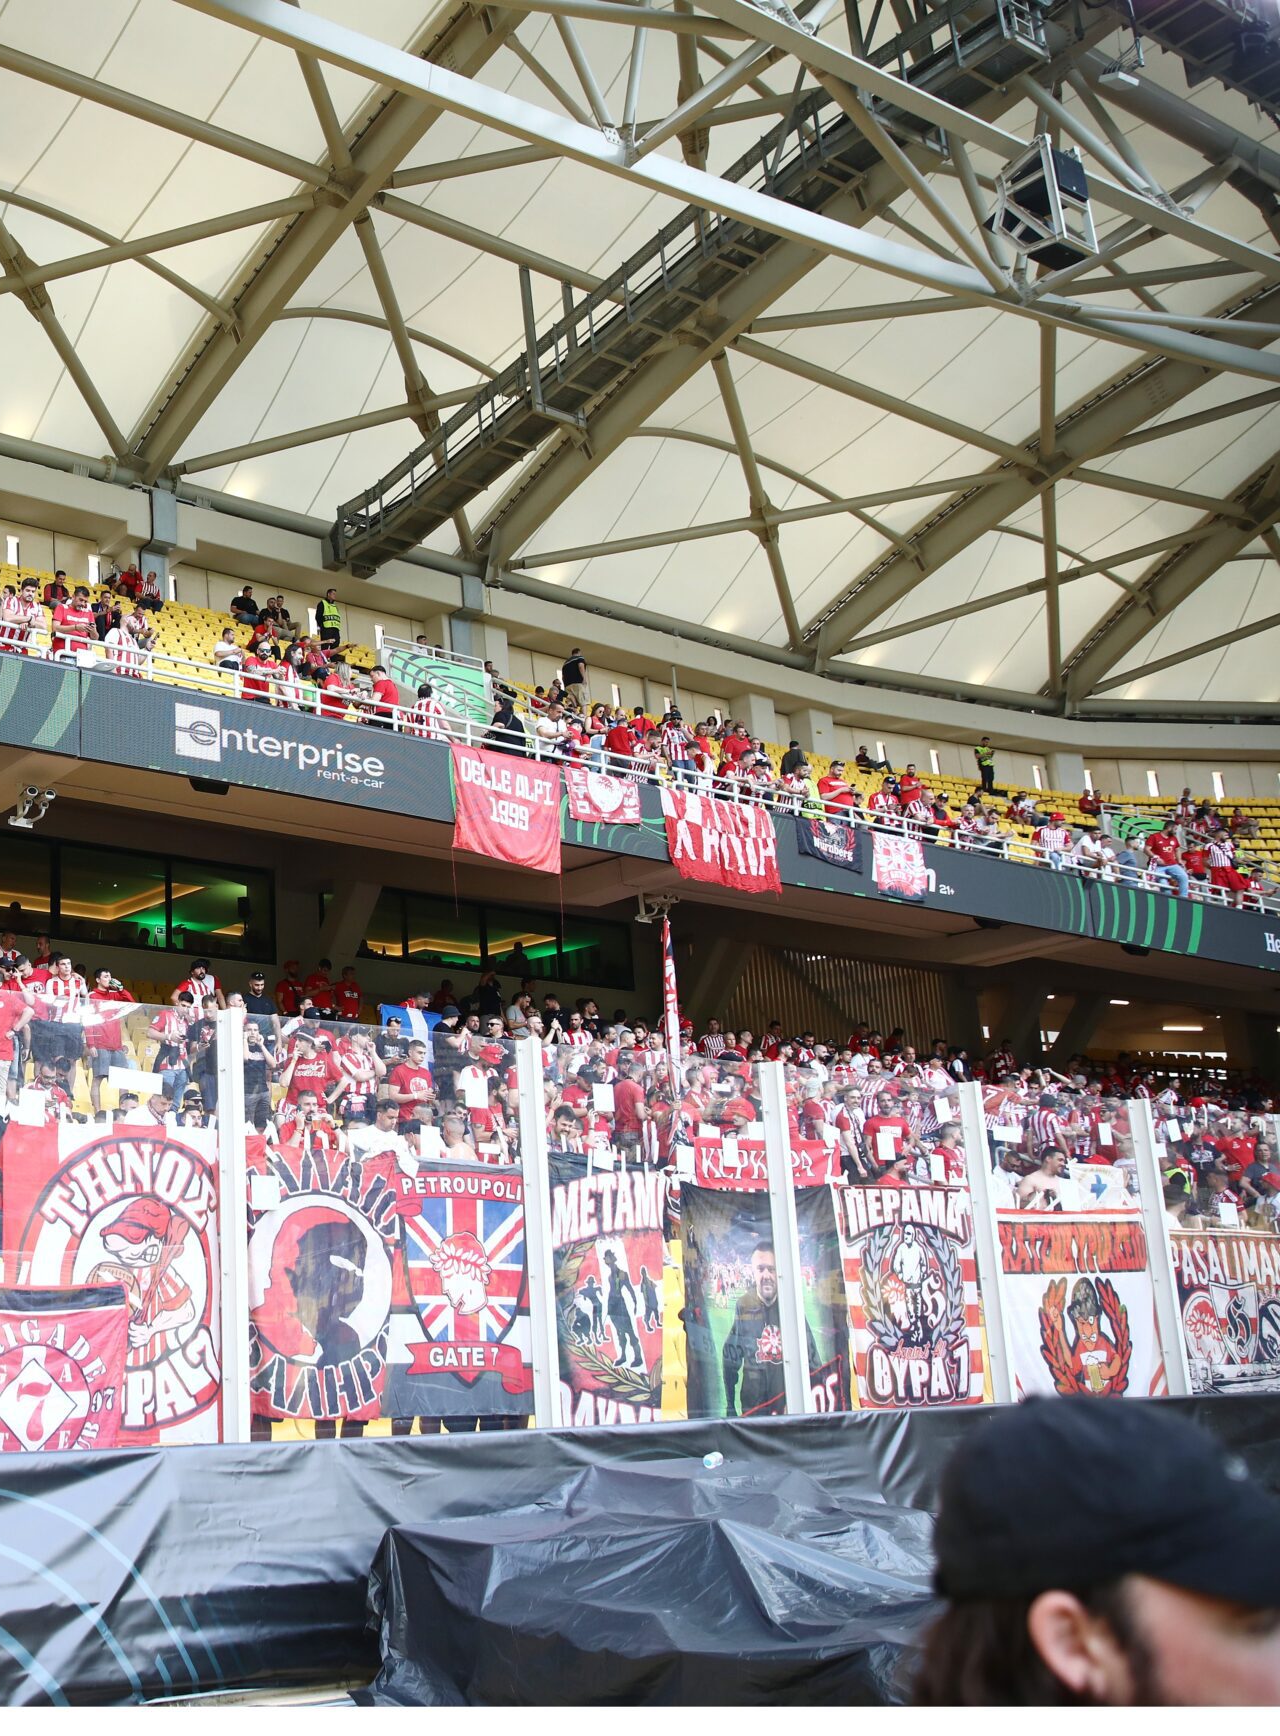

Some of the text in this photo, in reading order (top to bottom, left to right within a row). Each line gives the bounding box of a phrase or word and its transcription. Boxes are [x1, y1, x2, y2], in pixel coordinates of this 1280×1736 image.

[188, 720, 384, 777] enterprise
[317, 769, 385, 789] rent-a-car
[460, 756, 512, 794] DELLE
[516, 774, 555, 806] ALPI
[489, 797, 529, 831] 1999
[939, 884, 955, 896] 21+
[40, 1141, 217, 1231] ΤΗΝΟΣ
[401, 1176, 522, 1201] PETROUPOLI
[428, 1347, 500, 1367] GATE 7
[16, 1381, 52, 1442] 7
